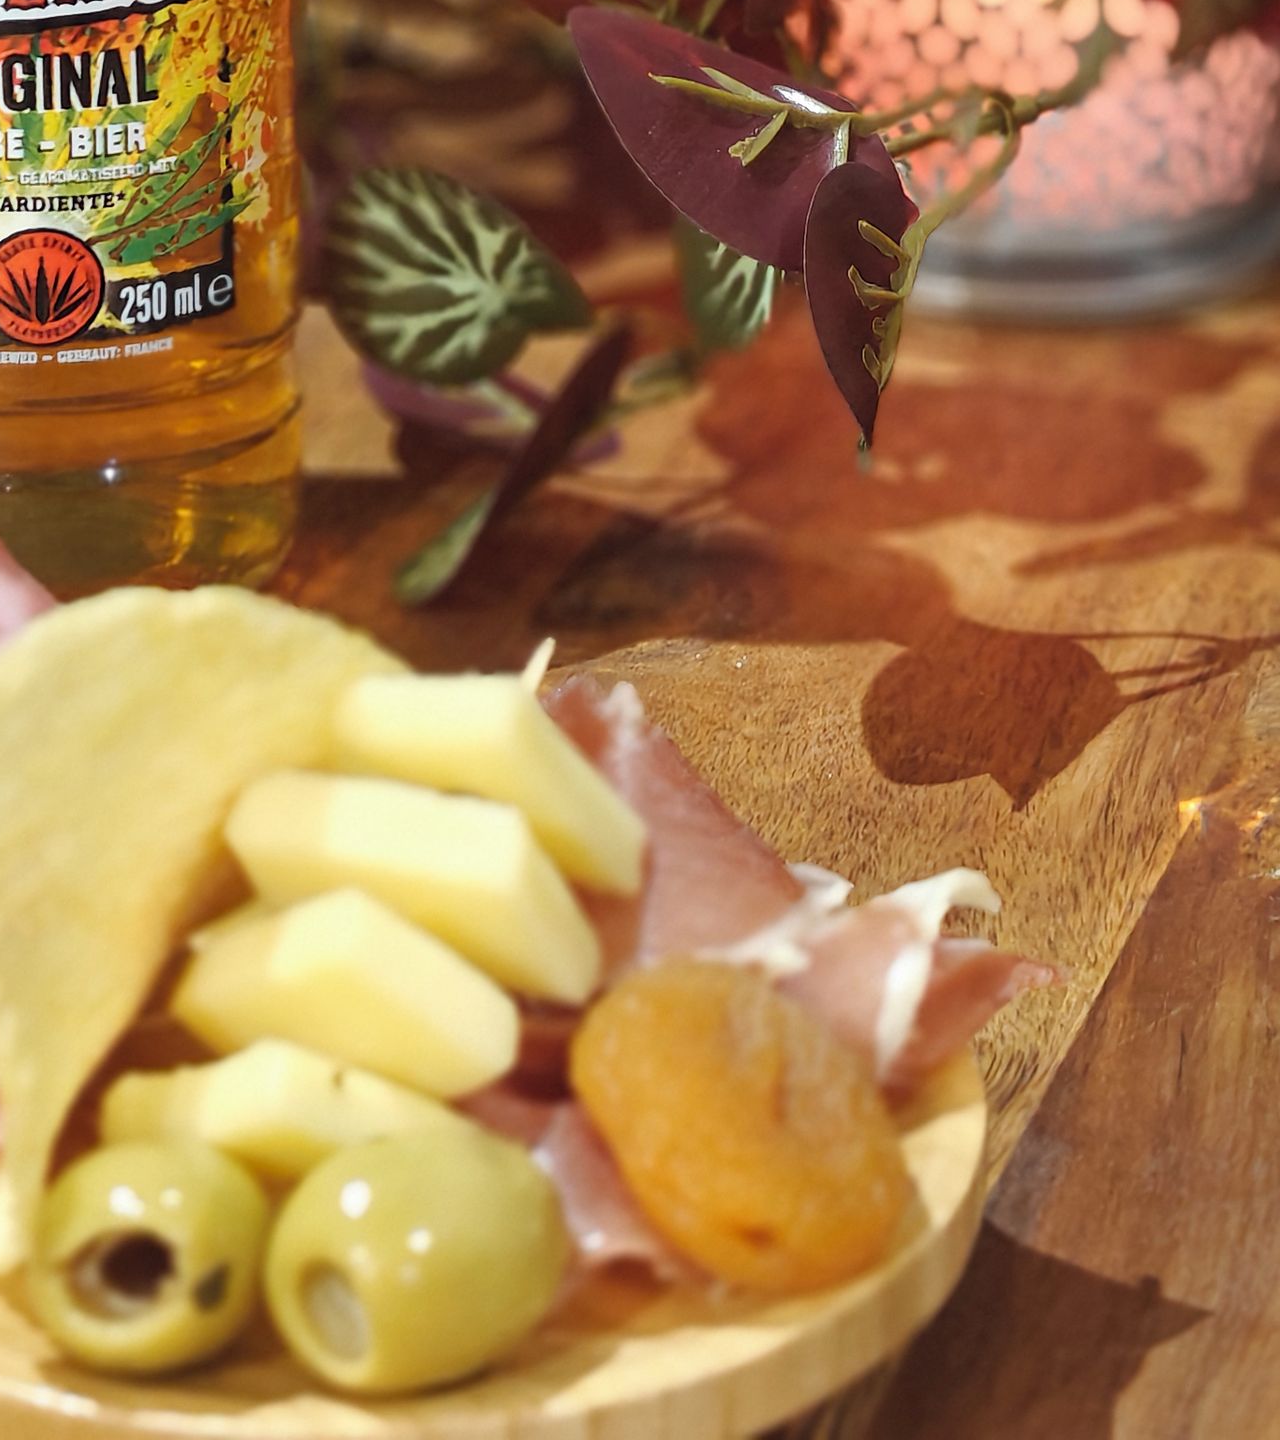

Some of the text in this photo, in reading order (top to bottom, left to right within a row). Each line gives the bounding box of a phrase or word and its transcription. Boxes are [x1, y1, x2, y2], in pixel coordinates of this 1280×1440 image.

[69, 122, 147, 159] BIER
[119, 280, 167, 325] 250
[174, 273, 202, 316] ml
